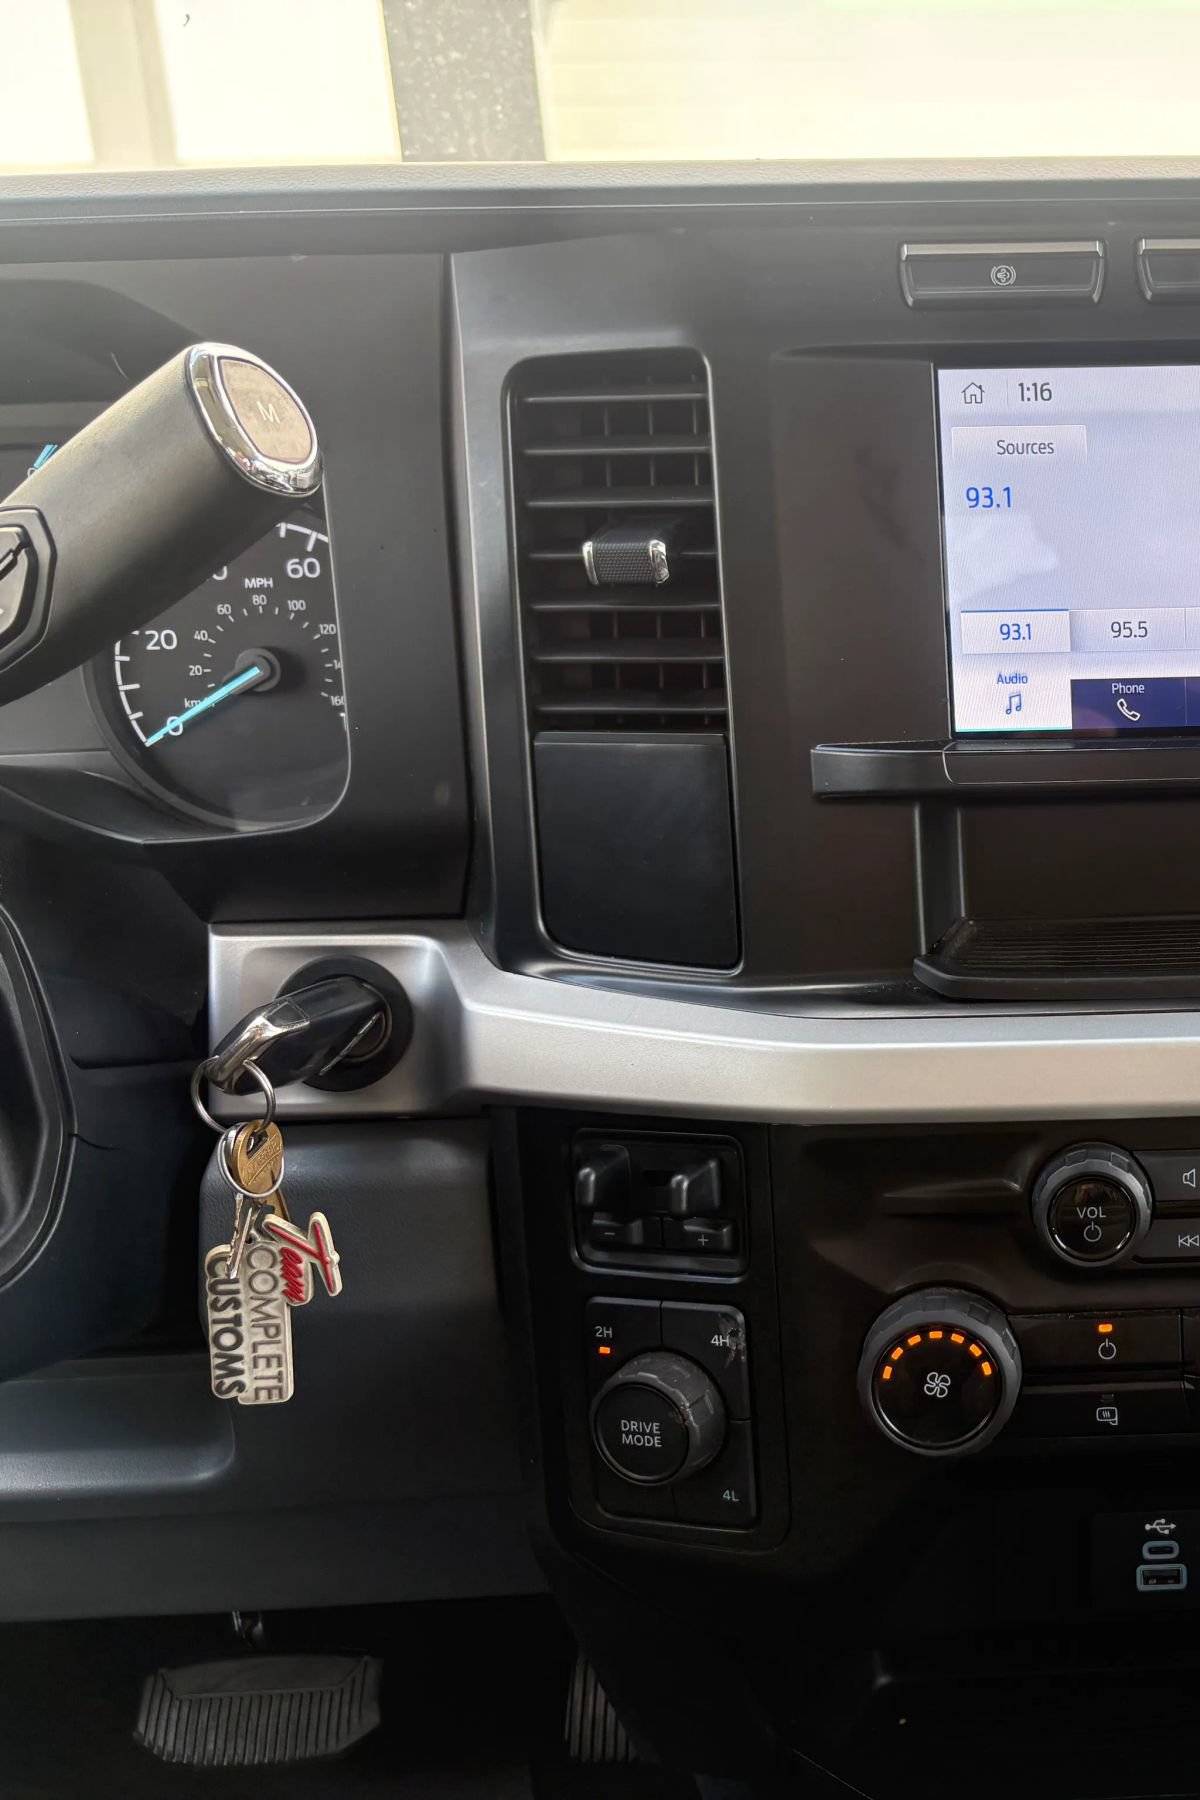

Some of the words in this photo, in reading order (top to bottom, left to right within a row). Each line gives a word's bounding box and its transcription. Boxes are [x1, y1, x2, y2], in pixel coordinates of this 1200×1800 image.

[1018, 382, 1053, 402] 1:16
[256, 400, 281, 424] M
[996, 439, 1055, 456] Sources
[965, 486, 1012, 509] 93.1
[286, 557, 321, 579] 60
[244, 577, 274, 589] MPH
[252, 594, 267, 606] 80
[287, 599, 306, 611] 100
[216, 604, 232, 615] 60
[193, 630, 208, 641] 40
[319, 623, 337, 635] 120
[999, 623, 1033, 641] 93.1
[1110, 620, 1149, 639] 95.5
[144, 629, 178, 651] 20
[188, 665, 203, 676] 20
[996, 673, 1029, 685] Audio
[1111, 682, 1145, 695] Phone
[1076, 1206, 1107, 1219] VOL
[267, 1221, 334, 1303] Team
[247, 1247, 284, 1402] COMPLETE
[594, 1325, 613, 1339] 2H
[710, 1334, 730, 1347] 4H
[620, 1419, 661, 1434] DRIVE
[622, 1433, 662, 1448] MODE
[722, 1490, 740, 1502] 4L
